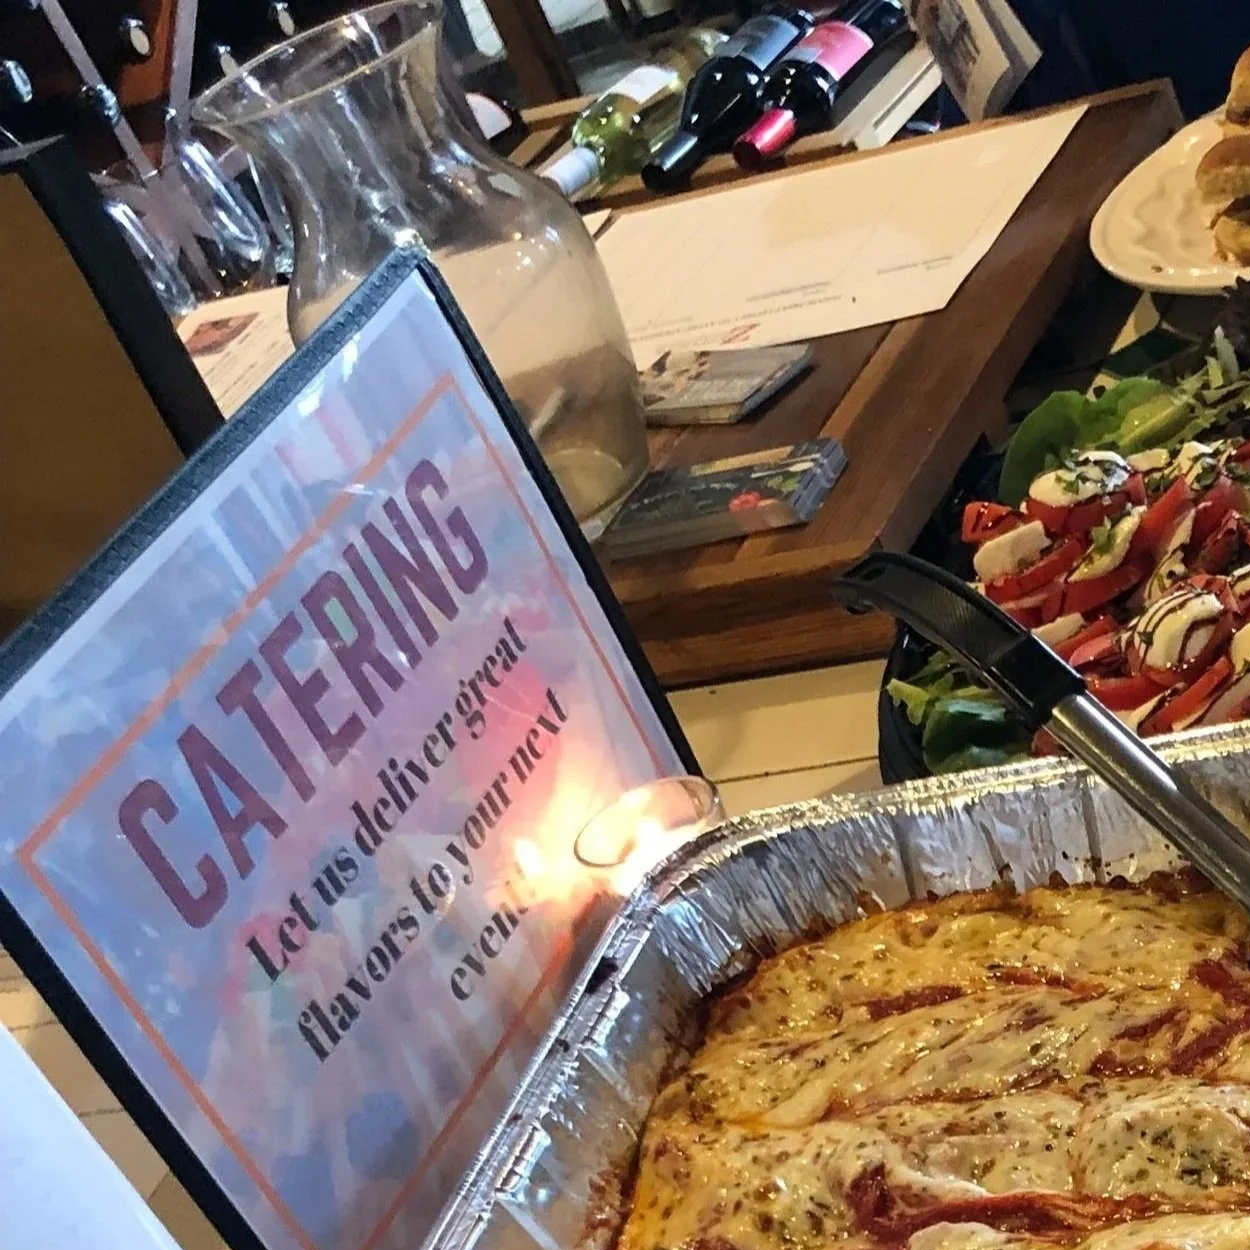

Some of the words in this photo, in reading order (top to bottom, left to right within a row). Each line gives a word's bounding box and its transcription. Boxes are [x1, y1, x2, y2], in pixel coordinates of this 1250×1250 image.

[119, 459, 489, 928] CATERING
[246, 891, 321, 981] Let
[312, 846, 359, 907] us
[351, 712, 458, 856] deliver
[455, 616, 527, 740] great
[298, 906, 420, 1062] flavors
[410, 862, 453, 914] to
[446, 771, 513, 885] your
[508, 687, 569, 784] next
